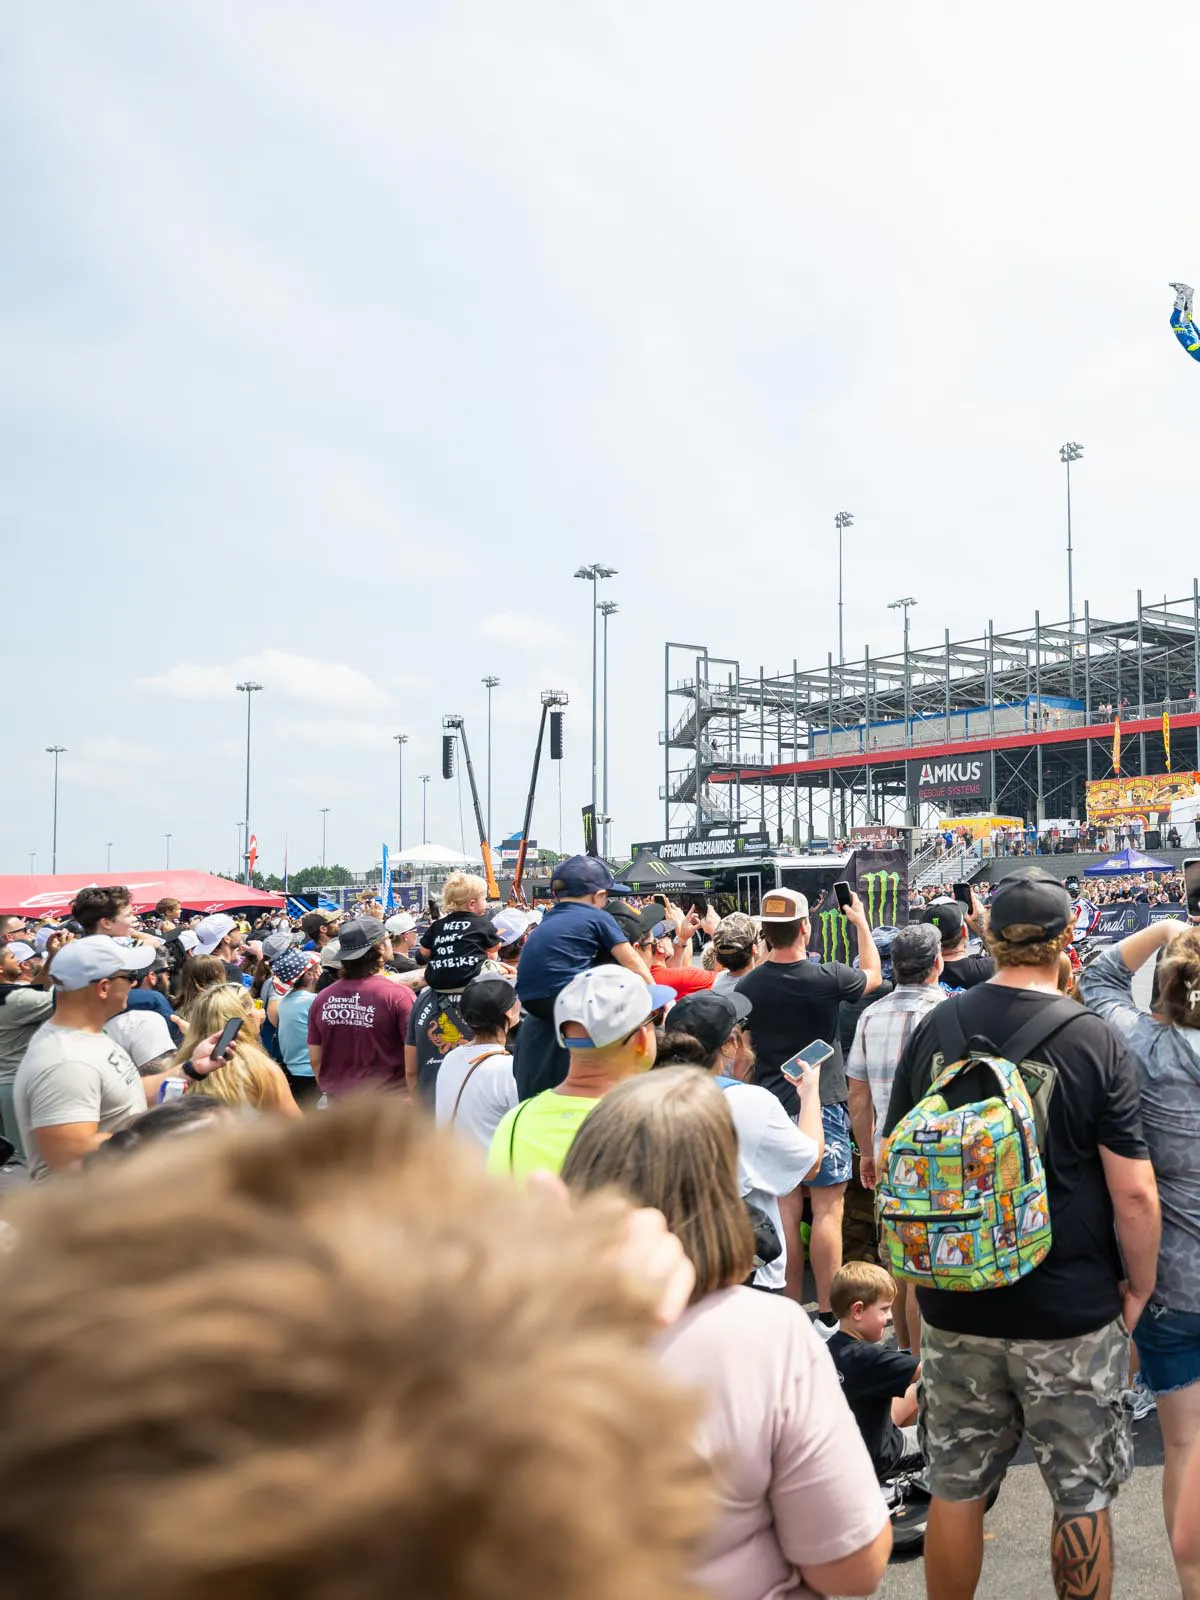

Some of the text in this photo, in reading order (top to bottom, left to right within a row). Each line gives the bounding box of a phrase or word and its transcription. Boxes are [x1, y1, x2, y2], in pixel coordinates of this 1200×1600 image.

[919, 761, 983, 786] AMKUS
[919, 784, 980, 799] RESCUE SYSTEMS
[659, 844, 687, 859] OFFICIAL
[688, 839, 736, 857] MERCHANDISE
[655, 881, 687, 889] MONSTER
[443, 921, 471, 931] NEED
[321, 1009, 375, 1023] ROOFING
[367, 1005, 376, 1013] &
